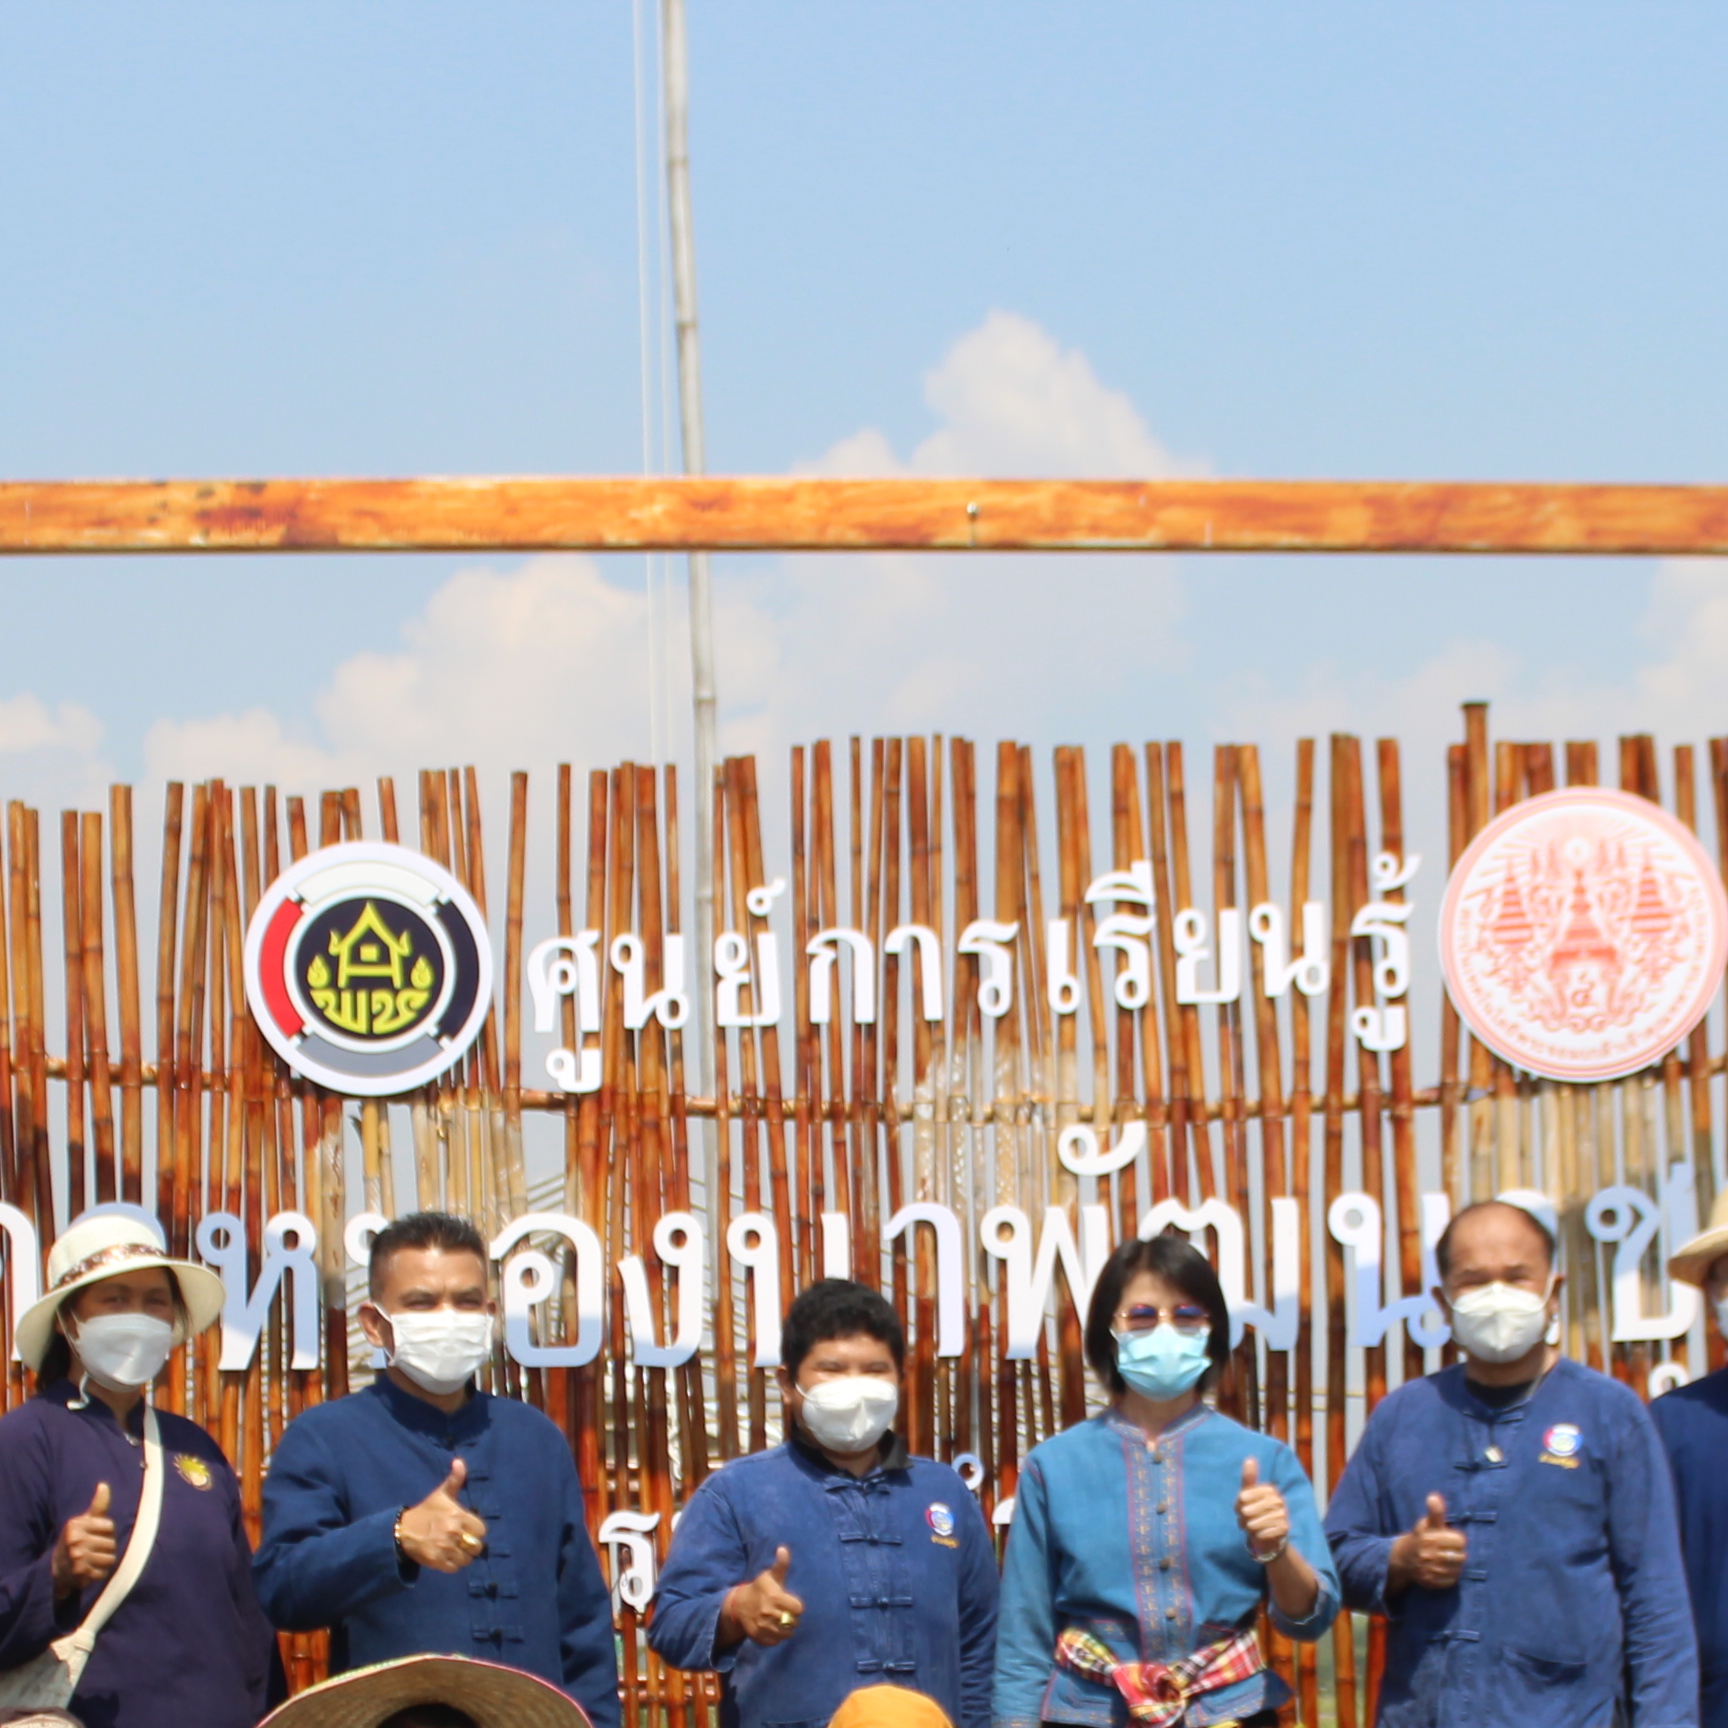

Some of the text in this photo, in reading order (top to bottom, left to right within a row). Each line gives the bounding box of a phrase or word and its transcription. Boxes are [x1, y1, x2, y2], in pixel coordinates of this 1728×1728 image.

[525, 850, 1420, 1094] ศูนย์การเรียนรู้
